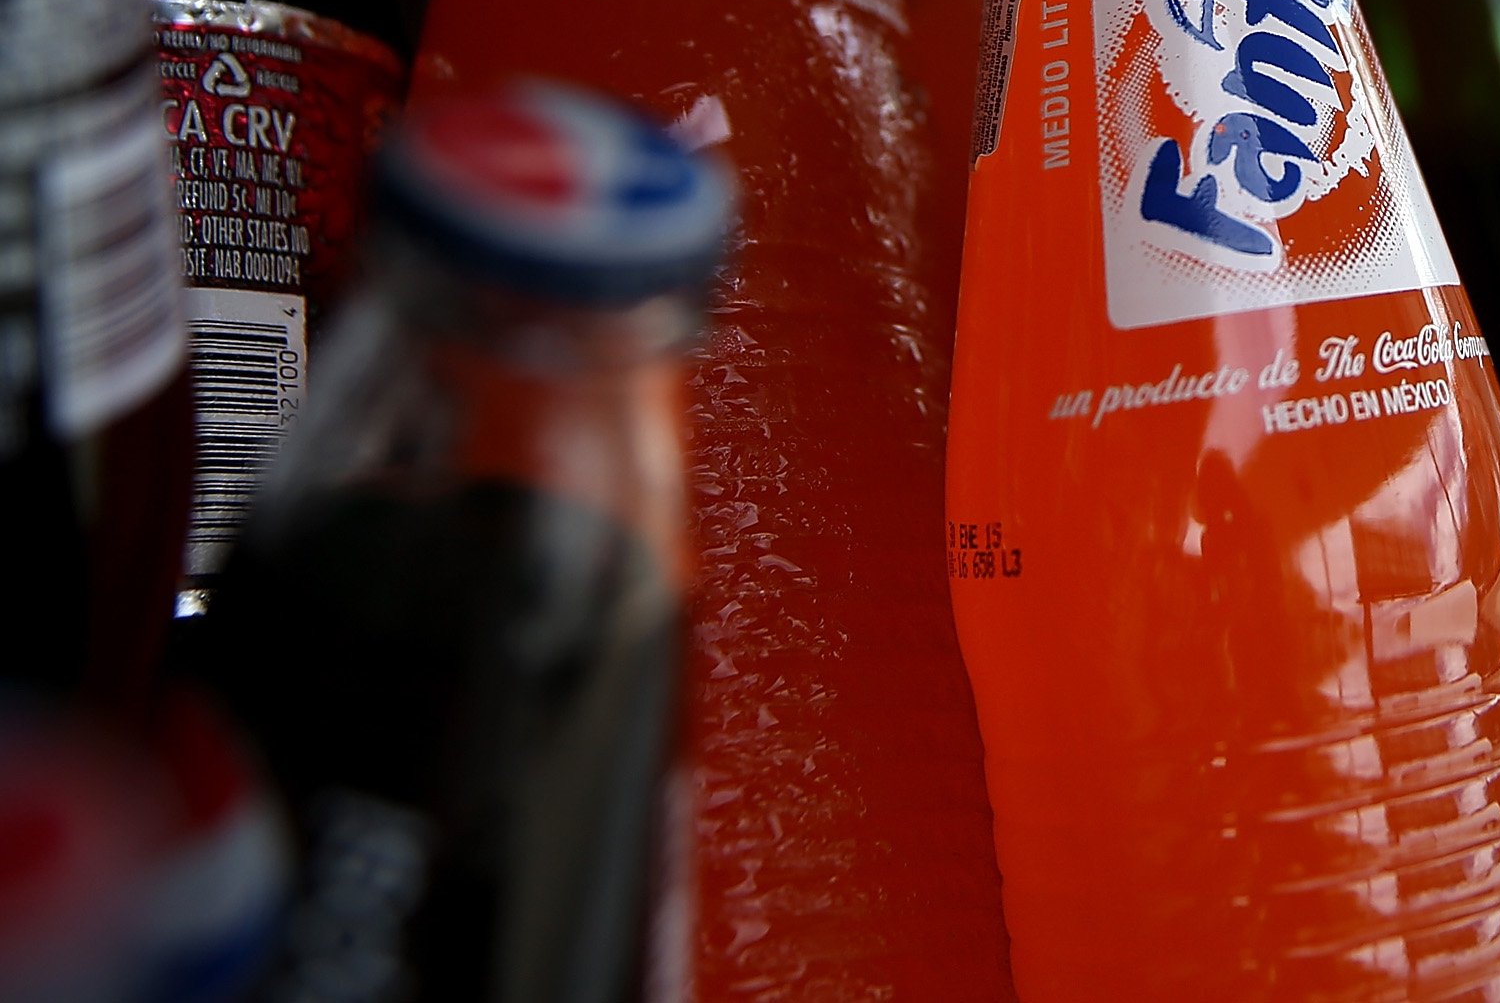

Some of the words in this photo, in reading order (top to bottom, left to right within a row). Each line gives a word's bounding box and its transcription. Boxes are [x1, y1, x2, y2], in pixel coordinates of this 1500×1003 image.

[160, 98, 209, 143] CA
[222, 102, 297, 154] CRV
[1041, 61, 1070, 171] MEDIO
[175, 179, 229, 212] REFUND
[202, 215, 245, 247] OTHER
[247, 219, 289, 253] STATES
[282, 306, 299, 319] 4
[1048, 386, 1094, 420] un
[1091, 362, 1251, 429] producto
[1258, 348, 1300, 390] de
[1314, 335, 1365, 383] The
[1262, 397, 1349, 435] HECHO
[1353, 393, 1382, 422] EN
[1384, 377, 1450, 416] MÉXICO
